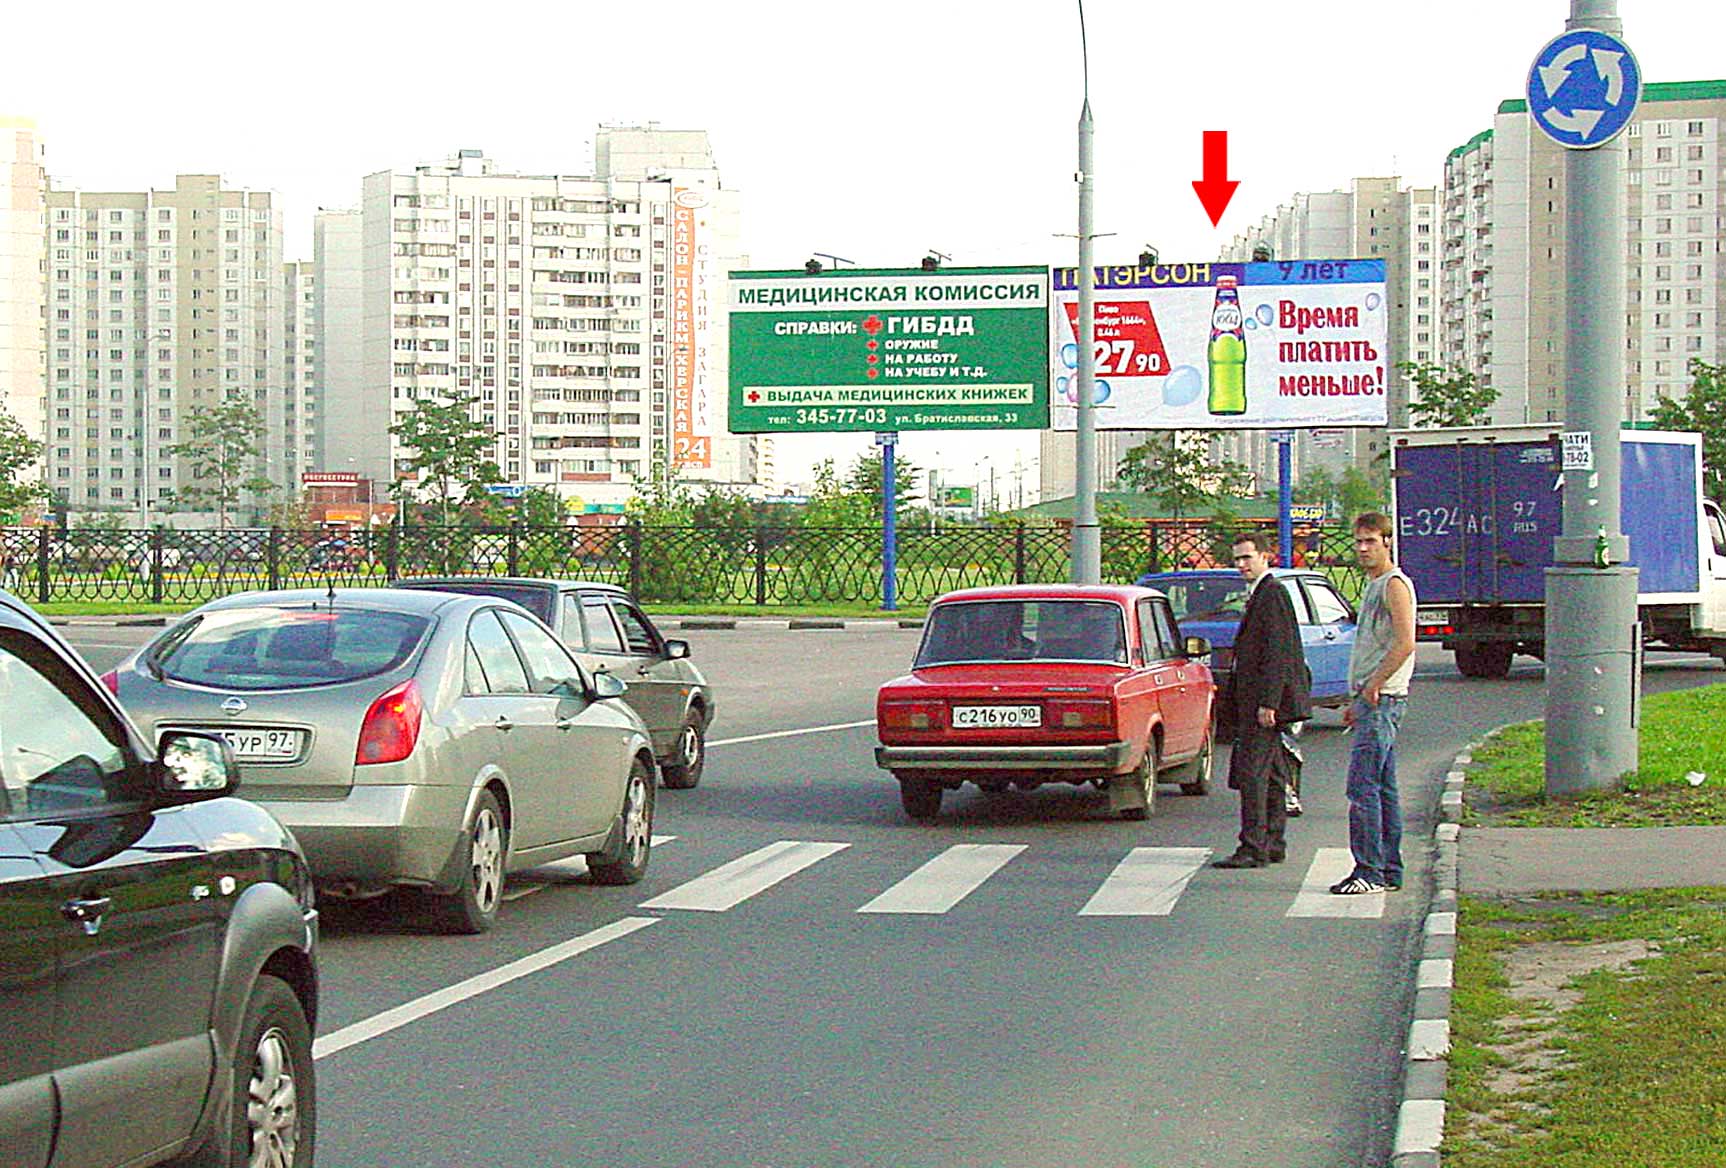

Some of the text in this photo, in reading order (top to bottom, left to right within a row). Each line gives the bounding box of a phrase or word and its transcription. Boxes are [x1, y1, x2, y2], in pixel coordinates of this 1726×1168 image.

[1060, 263, 1210, 287] ПТЭРСОН
[1301, 261, 1350, 280] лет
[739, 284, 1040, 306] МЕДИЦИНСКАЯ КОМИССИЯ
[774, 315, 975, 336] СПРАВКИ: ГИБДД
[1279, 300, 1359, 335] Время
[885, 339, 939, 350] ОРУЖИЕ
[1279, 340, 1378, 363] платить
[885, 353, 958, 364] НА РАБОТУ
[1093, 340, 1161, 374] 27 90
[885, 367, 904, 377] НА
[905, 367, 947, 377] УЧЕБУ
[949, 367, 960, 377] И
[1279, 366, 1383, 396] меньше!
[767, 388, 1028, 402] ВЫДАЧА МЕДИЦИНСКИХ КНИЖЕК
[796, 408, 887, 424] 345-77-03
[675, 437, 706, 460] 24
[1020, 707, 1037, 719] 90
[267, 732, 288, 748] 97
